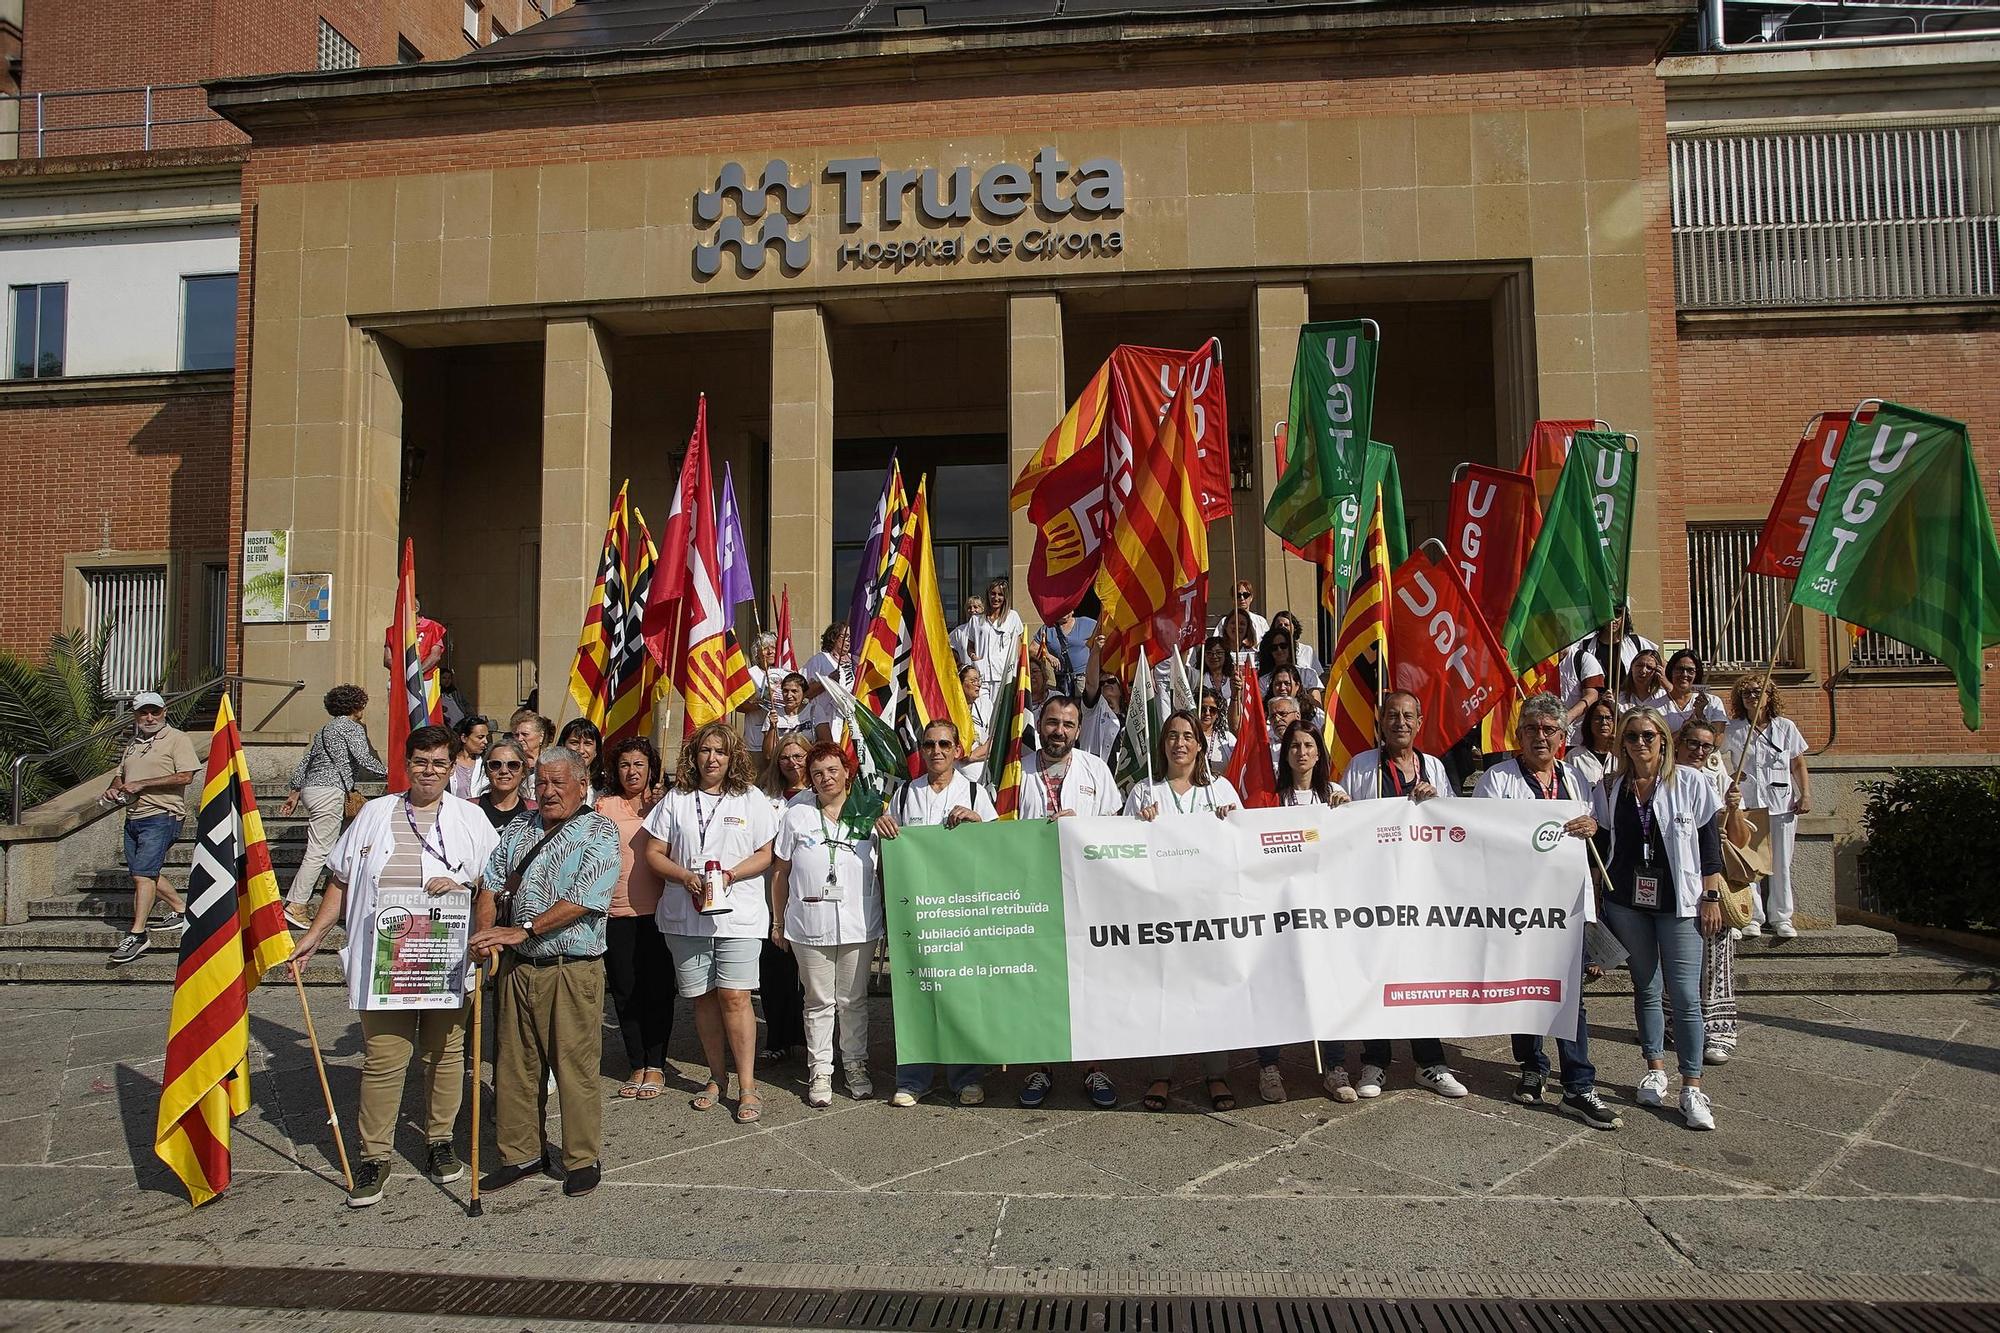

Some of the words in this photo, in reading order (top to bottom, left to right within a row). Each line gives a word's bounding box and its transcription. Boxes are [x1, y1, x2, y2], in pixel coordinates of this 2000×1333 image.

[825, 146, 1125, 228] Trueta
[842, 232, 965, 266] Hospital
[974, 231, 1013, 255] de
[1022, 227, 1125, 251] Girona
[1825, 424, 1918, 573] UGT
[247, 537, 275, 545] HOSPITAL
[1460, 480, 1497, 592] UGT
[247, 546, 267, 554] LLIURE
[255, 554, 269, 562] FUM
[1811, 576, 1839, 596] .cat
[1263, 833, 1301, 843] CCOO
[1409, 825, 1446, 842] UGT
[1539, 830, 1565, 842] CSIF
[1083, 844, 1148, 860] SATSE
[1156, 847, 1200, 858] Catalunya
[1263, 844, 1302, 855] sanitat
[1641, 879, 1655, 888] UGT
[915, 896, 945, 906] Nova
[948, 889, 1021, 904] classificació
[428, 908, 441, 920] 16
[916, 906, 989, 921] professional
[991, 903, 1049, 916] retribuïda
[382, 914, 408, 925] ESTATUT
[1089, 924, 1130, 947] UN
[1137, 914, 1266, 945] ESTATUT
[1273, 908, 1329, 933] PER
[1334, 905, 1419, 928] PODER
[1426, 905, 1567, 935] AVANÇAR
[386, 923, 405, 932] MARC
[917, 927, 971, 940] Jubilació
[973, 924, 1035, 938] anticipada
[918, 944, 922, 954] i
[924, 942, 964, 955] parcial
[918, 967, 956, 978] Millora
[959, 966, 974, 977] de
[976, 965, 987, 975] la
[988, 962, 1038, 977] jornada.
[920, 981, 933, 992] 35
[934, 980, 942, 991] h
[1391, 991, 1404, 1000] UN
[1405, 990, 1447, 1000] ESTATUT
[1449, 989, 1469, 999] PER
[1471, 990, 1480, 998] A
[1482, 987, 1515, 998] TOTES
[1516, 987, 1520, 995] I
[1521, 986, 1550, 995] TOTS
